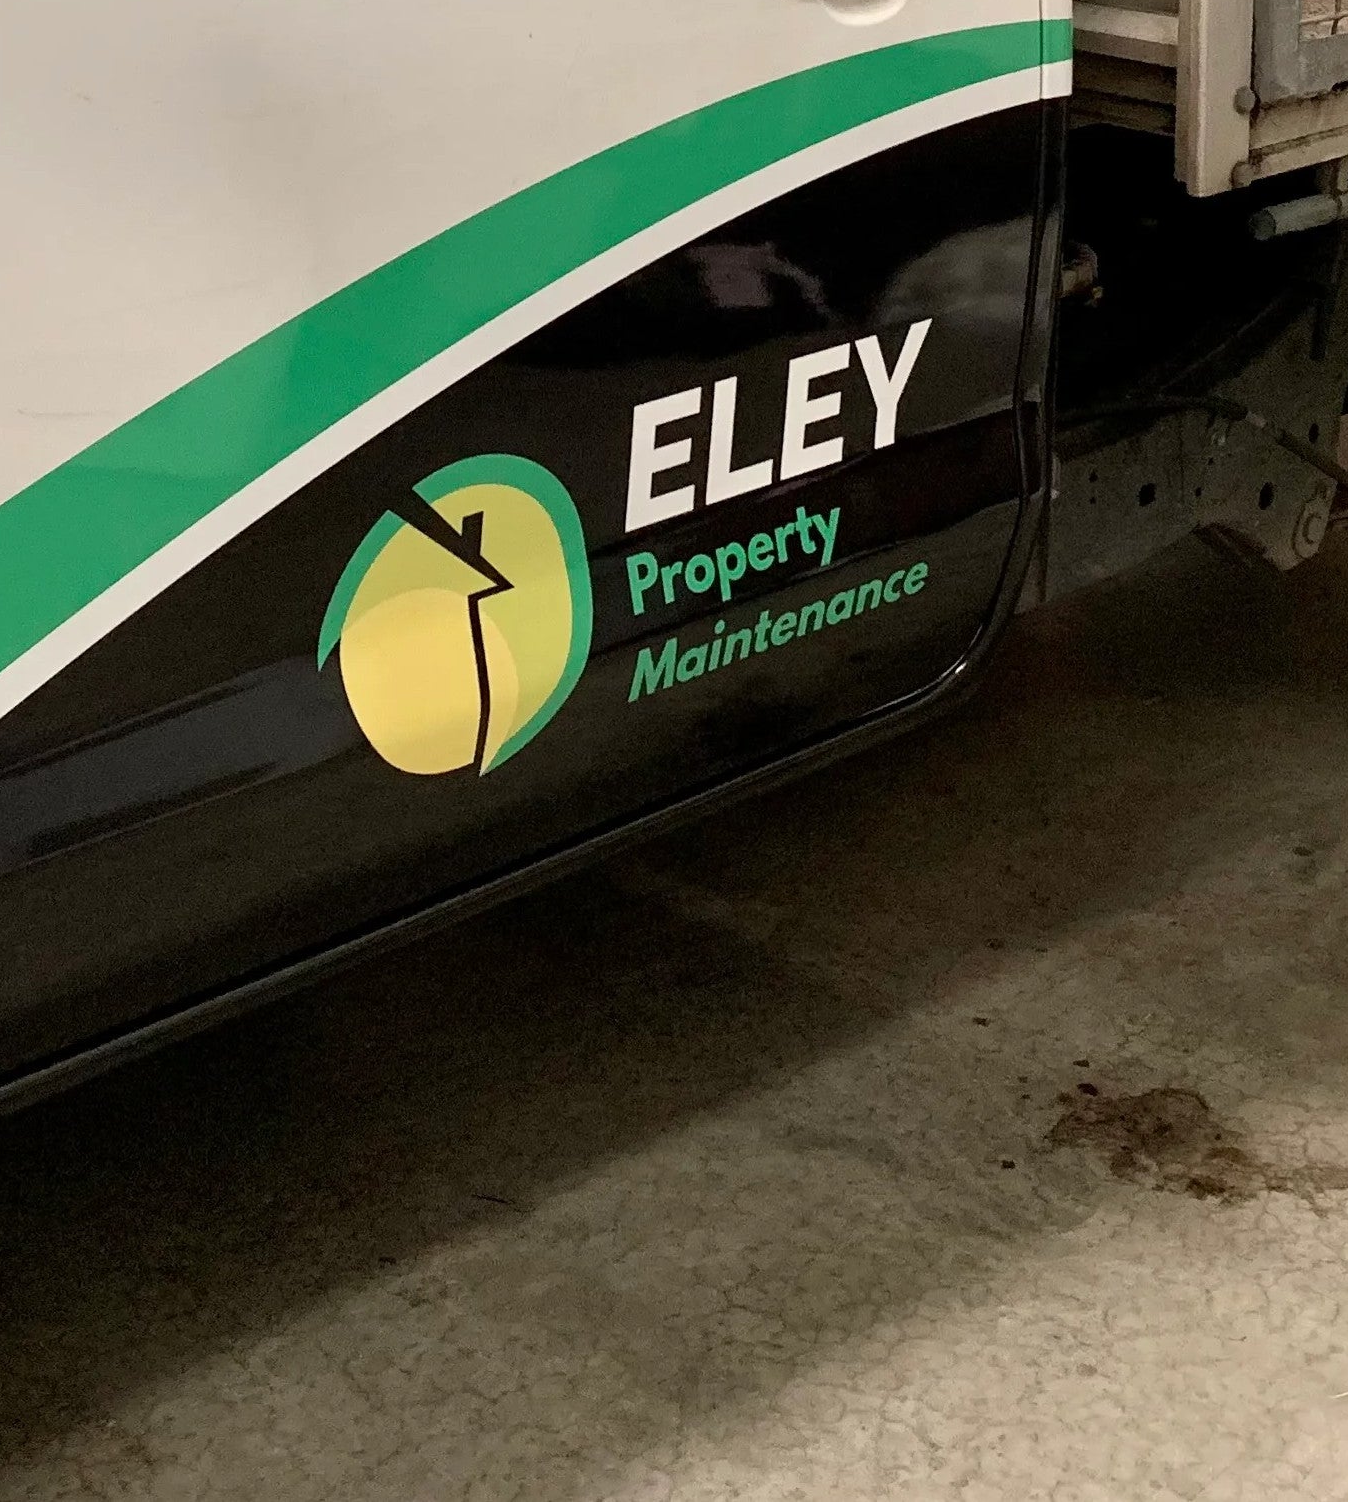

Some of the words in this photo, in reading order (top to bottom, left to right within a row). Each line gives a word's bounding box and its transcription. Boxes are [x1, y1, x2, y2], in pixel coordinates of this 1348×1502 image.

[624, 318, 933, 533] ELEY
[626, 506, 841, 615] Property
[628, 562, 930, 703] Maintenance
